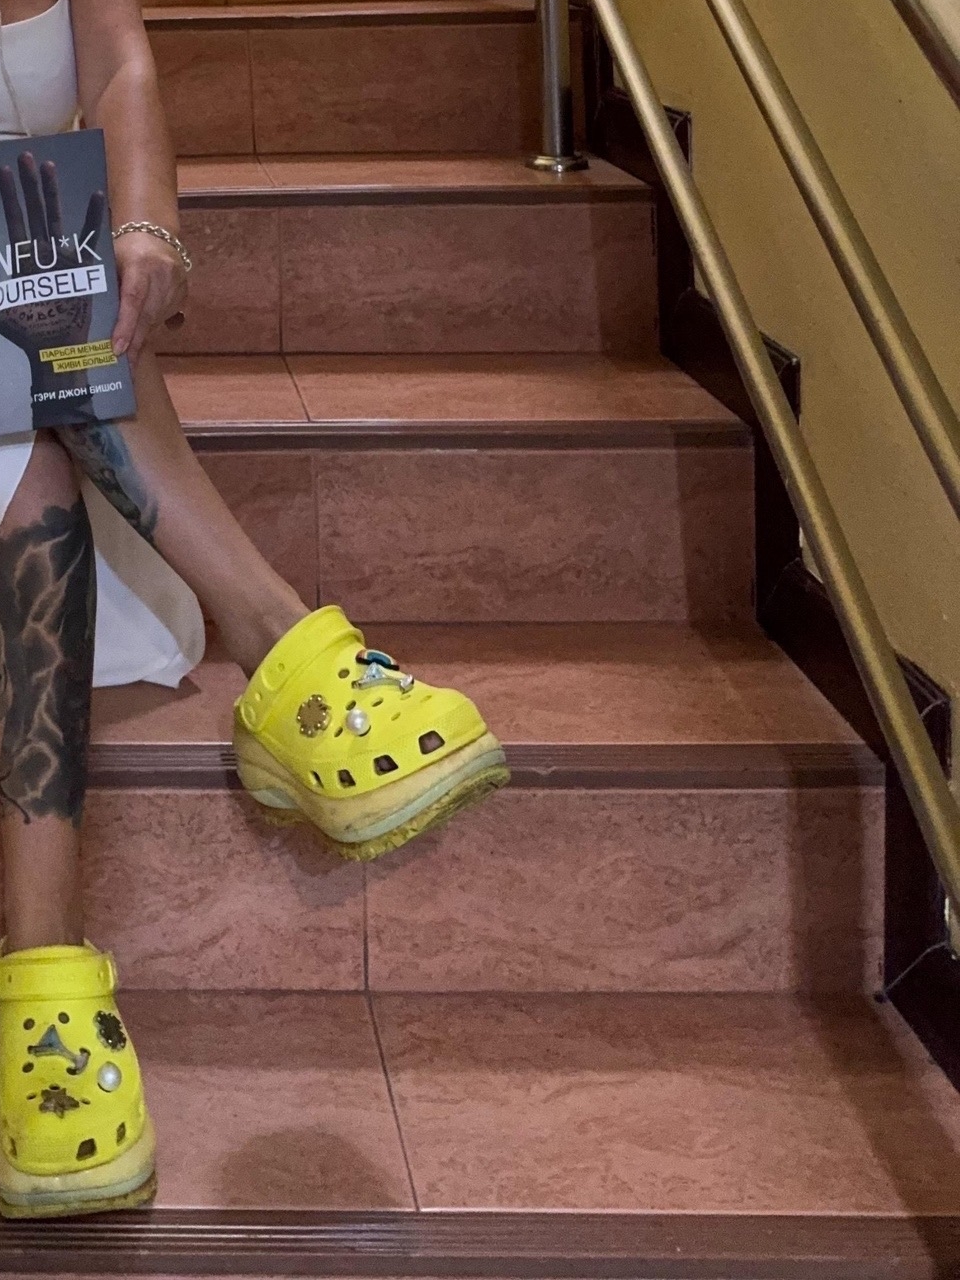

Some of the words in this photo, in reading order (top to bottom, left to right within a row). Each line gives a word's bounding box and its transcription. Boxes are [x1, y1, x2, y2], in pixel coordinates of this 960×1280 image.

[41, 347, 76, 360] ПАРЬСЯ
[77, 341, 111, 354] МЕНЬШЕ
[56, 360, 81, 371] ЖИВИ
[82, 355, 116, 367] БОЛЬШЕ
[33, 391, 56, 402] ГЭРИ
[58, 387, 88, 400] ДЖОН
[89, 381, 123, 395] БИШОП
